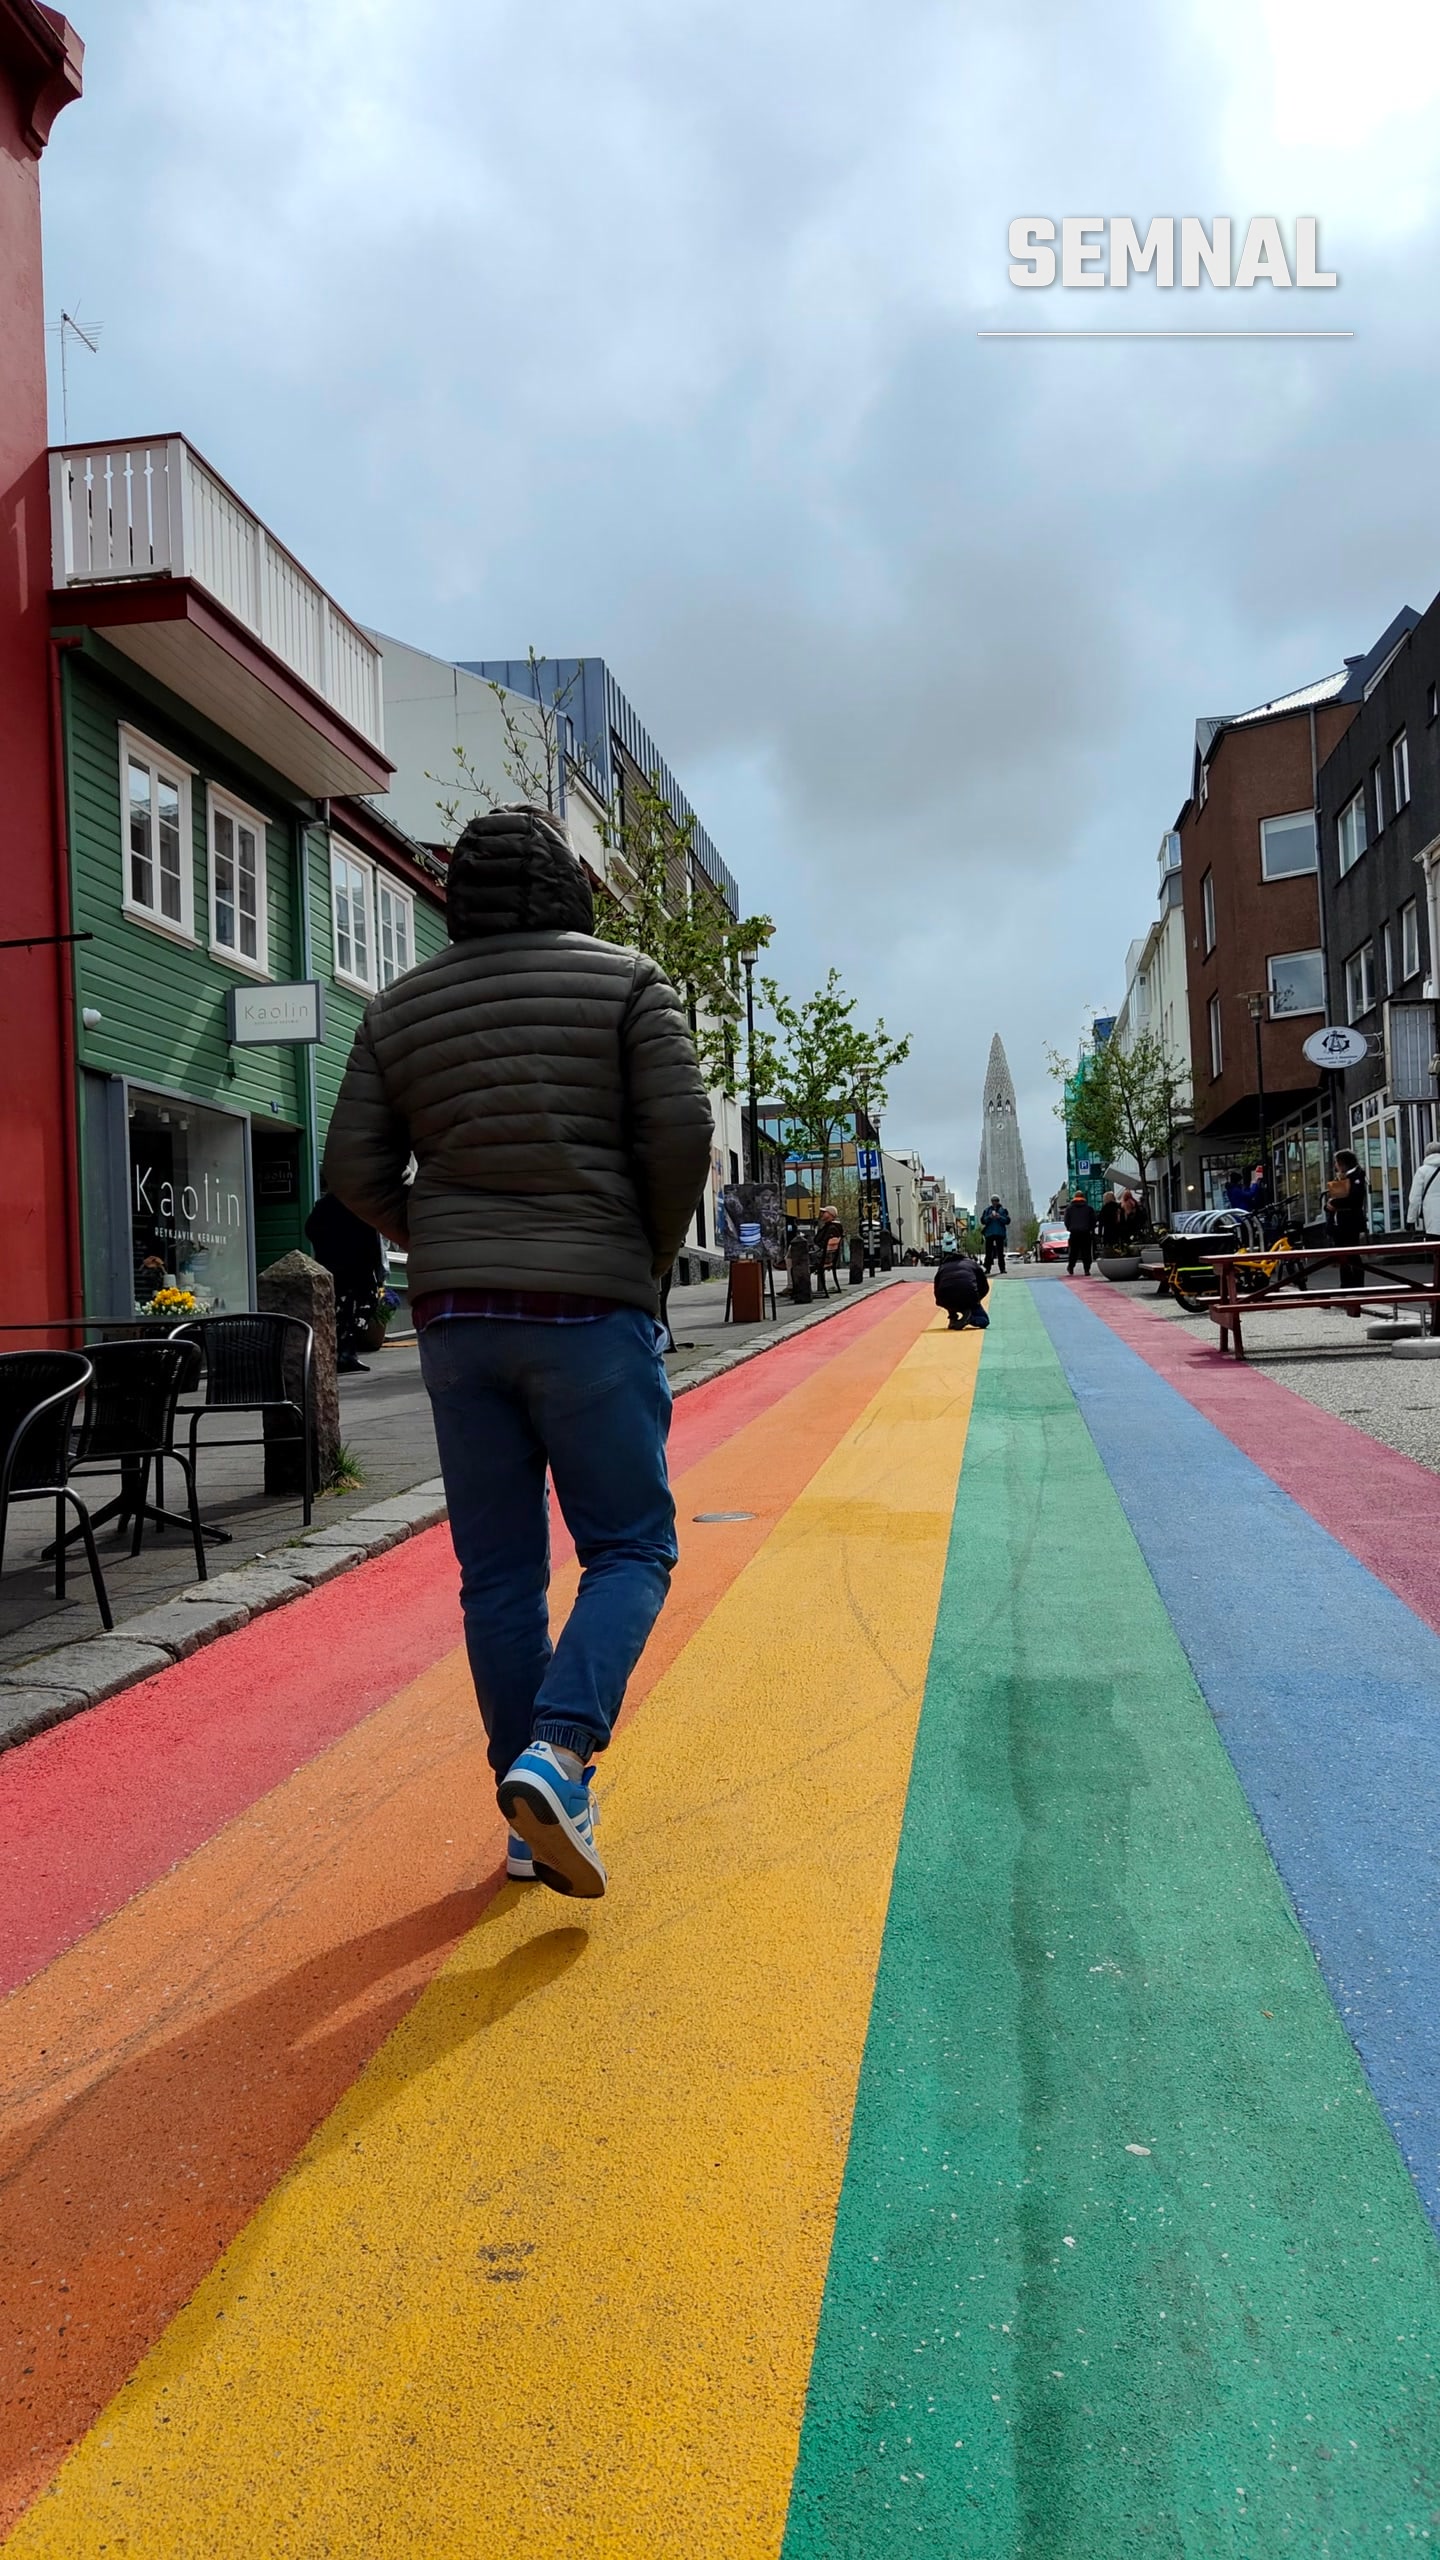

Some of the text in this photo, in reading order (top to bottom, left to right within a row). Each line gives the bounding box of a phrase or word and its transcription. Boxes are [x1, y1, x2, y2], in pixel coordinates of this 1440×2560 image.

[244, 1002, 308, 1020] Kaolin
[136, 1164, 240, 1227] Kaolin
[154, 1226, 227, 1245] REYKJAVIK KERAMIK
